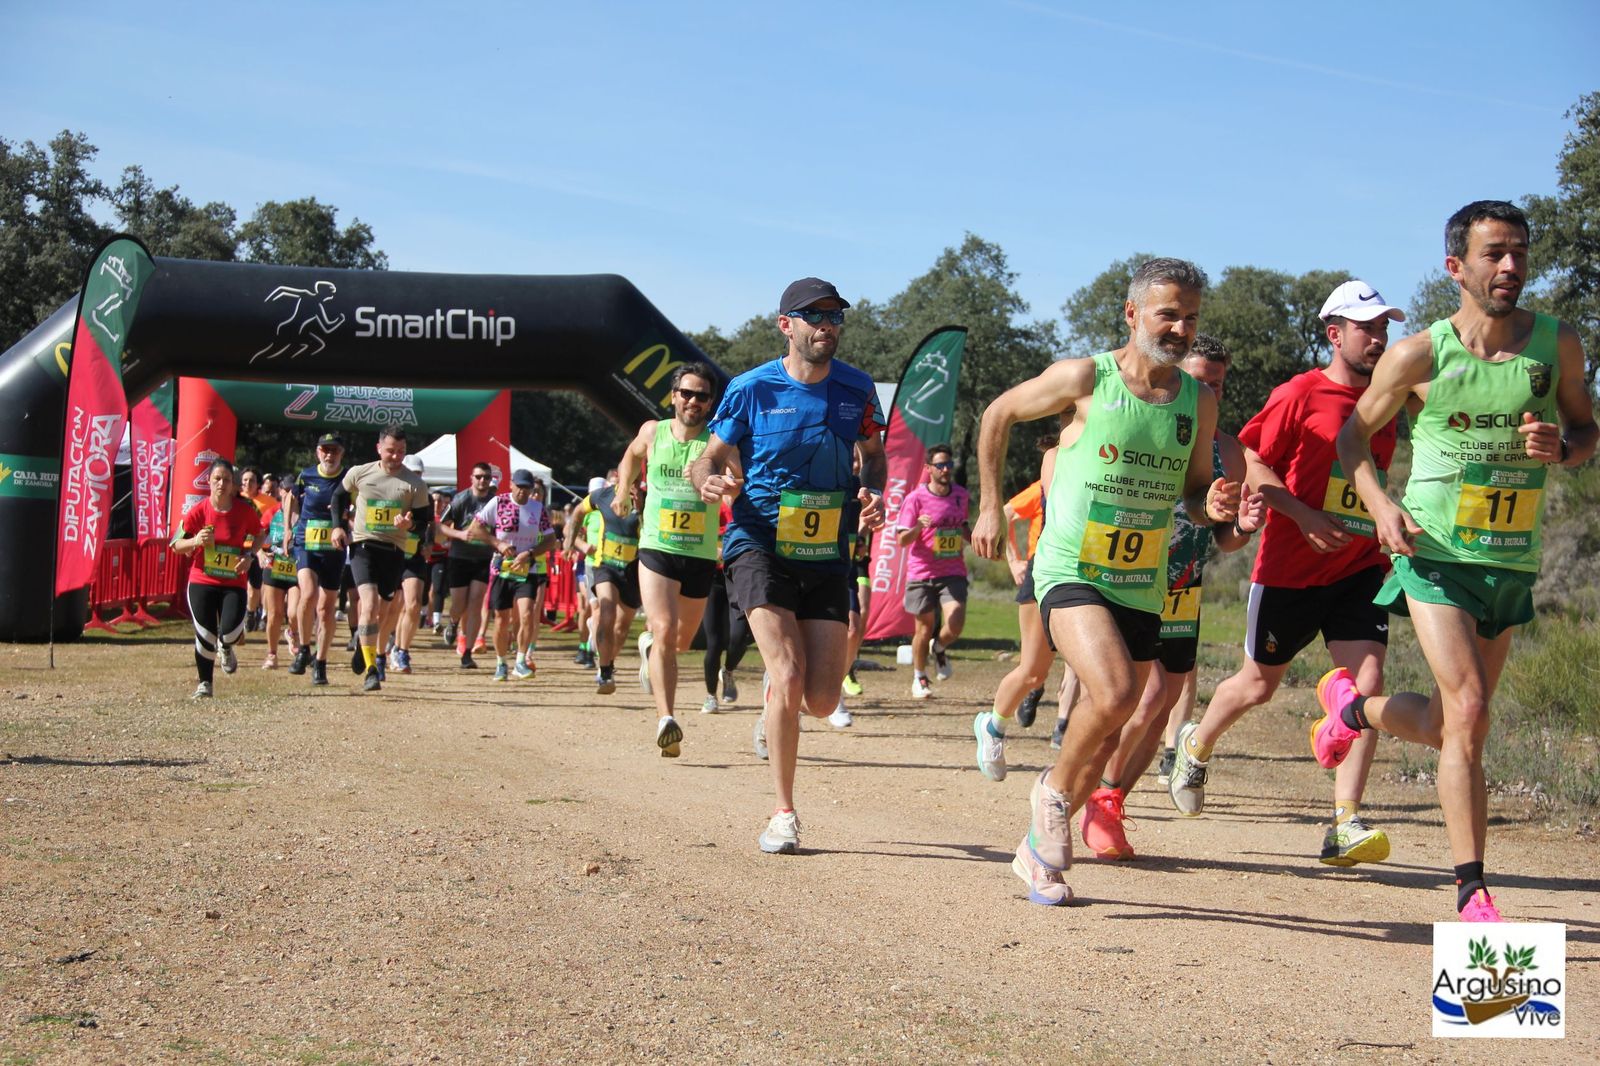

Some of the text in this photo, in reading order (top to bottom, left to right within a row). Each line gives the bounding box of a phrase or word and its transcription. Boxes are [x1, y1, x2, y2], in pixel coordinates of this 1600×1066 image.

[355, 306, 516, 347] SmartChip
[324, 402, 418, 426] ZAMORA
[1460, 439, 1527, 450] CLUBE ATLÉT
[1440, 450, 1532, 462] MACEDO DE CAVA
[13, 470, 60, 482] CAJA RUR
[1104, 473, 1135, 486] CLUBE
[83, 414, 122, 560] ZAMORA
[1085, 481, 1123, 495] MACEDO
[1127, 489, 1140, 498] DE
[1341, 483, 1369, 513] 6
[1486, 490, 1517, 524] 11
[375, 508, 390, 522] 51
[670, 511, 691, 530] 12
[804, 511, 820, 538] 9
[312, 528, 328, 540] 70
[1479, 535, 1528, 546] CAJA RURAL
[613, 544, 622, 556] 4
[940, 537, 955, 549] 20
[1105, 529, 1144, 563] 19
[795, 547, 836, 556] CAJA RURAL
[213, 553, 230, 567] 41
[278, 561, 293, 573] 58
[1101, 574, 1153, 583] CAJA RURAL
[1161, 590, 1184, 615] 7
